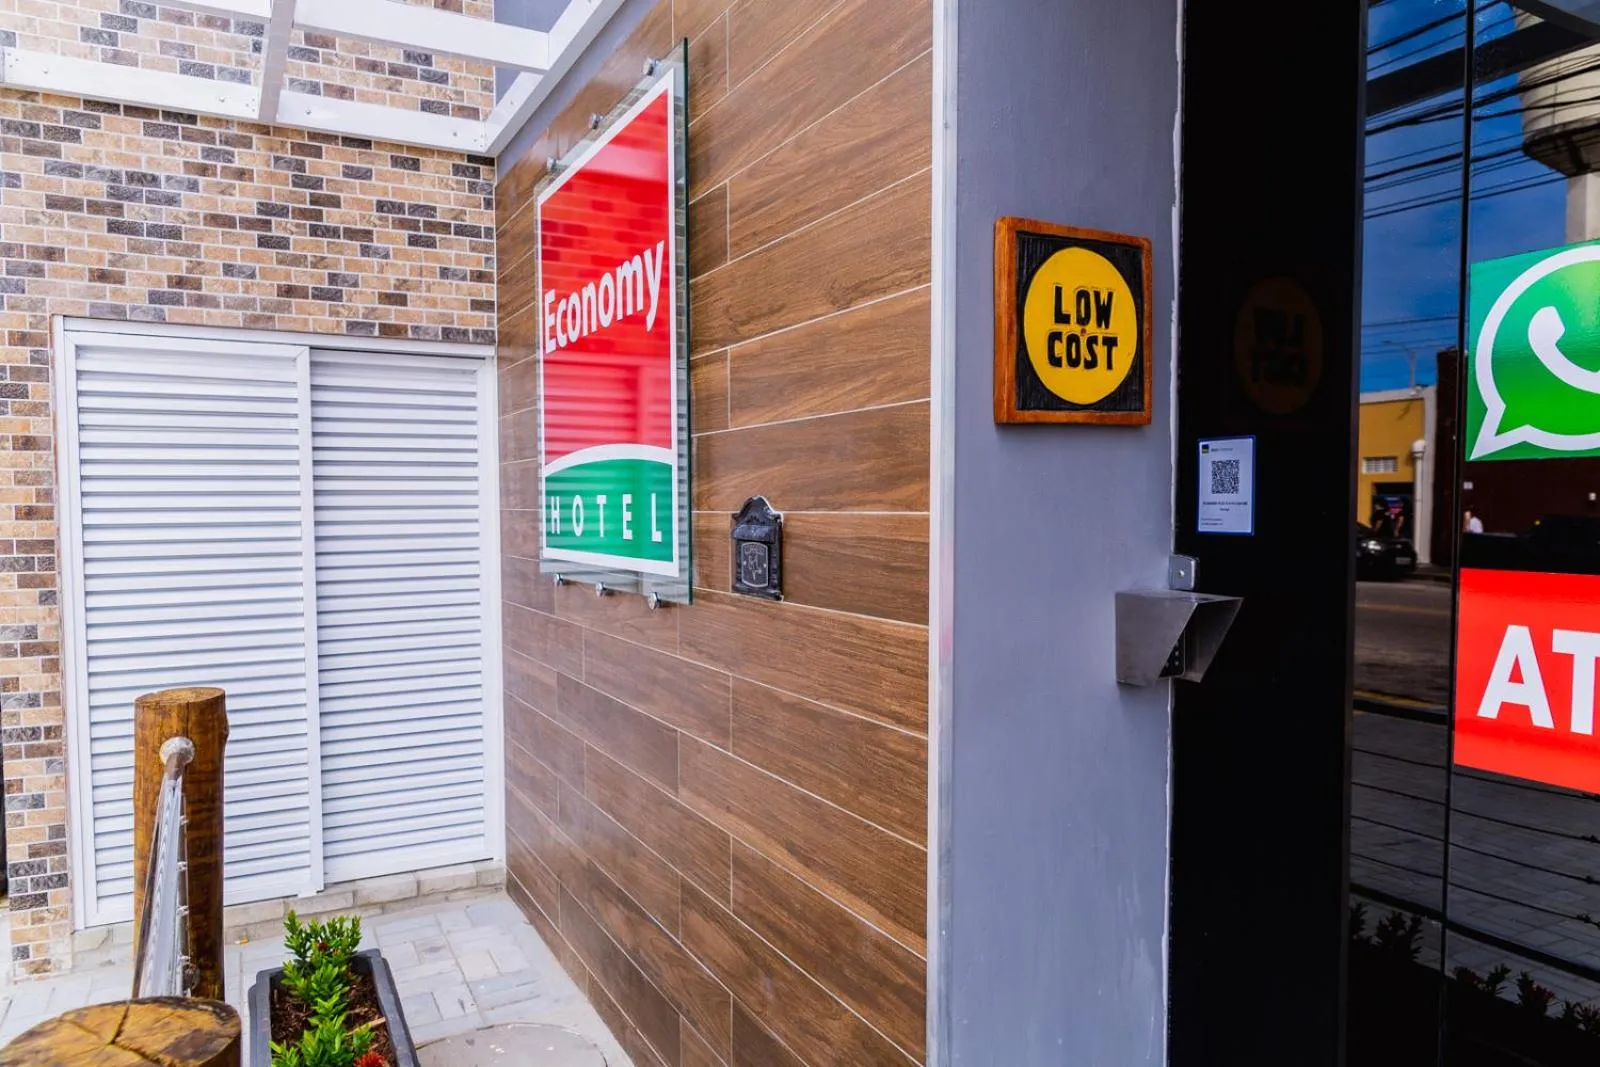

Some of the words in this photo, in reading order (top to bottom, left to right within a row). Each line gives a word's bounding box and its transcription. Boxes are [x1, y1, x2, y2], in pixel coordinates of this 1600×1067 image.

[544, 240, 664, 354] Economy
[1054, 285, 1114, 329] LOW
[1047, 331, 1118, 371] COST
[550, 493, 662, 542] HOTEL
